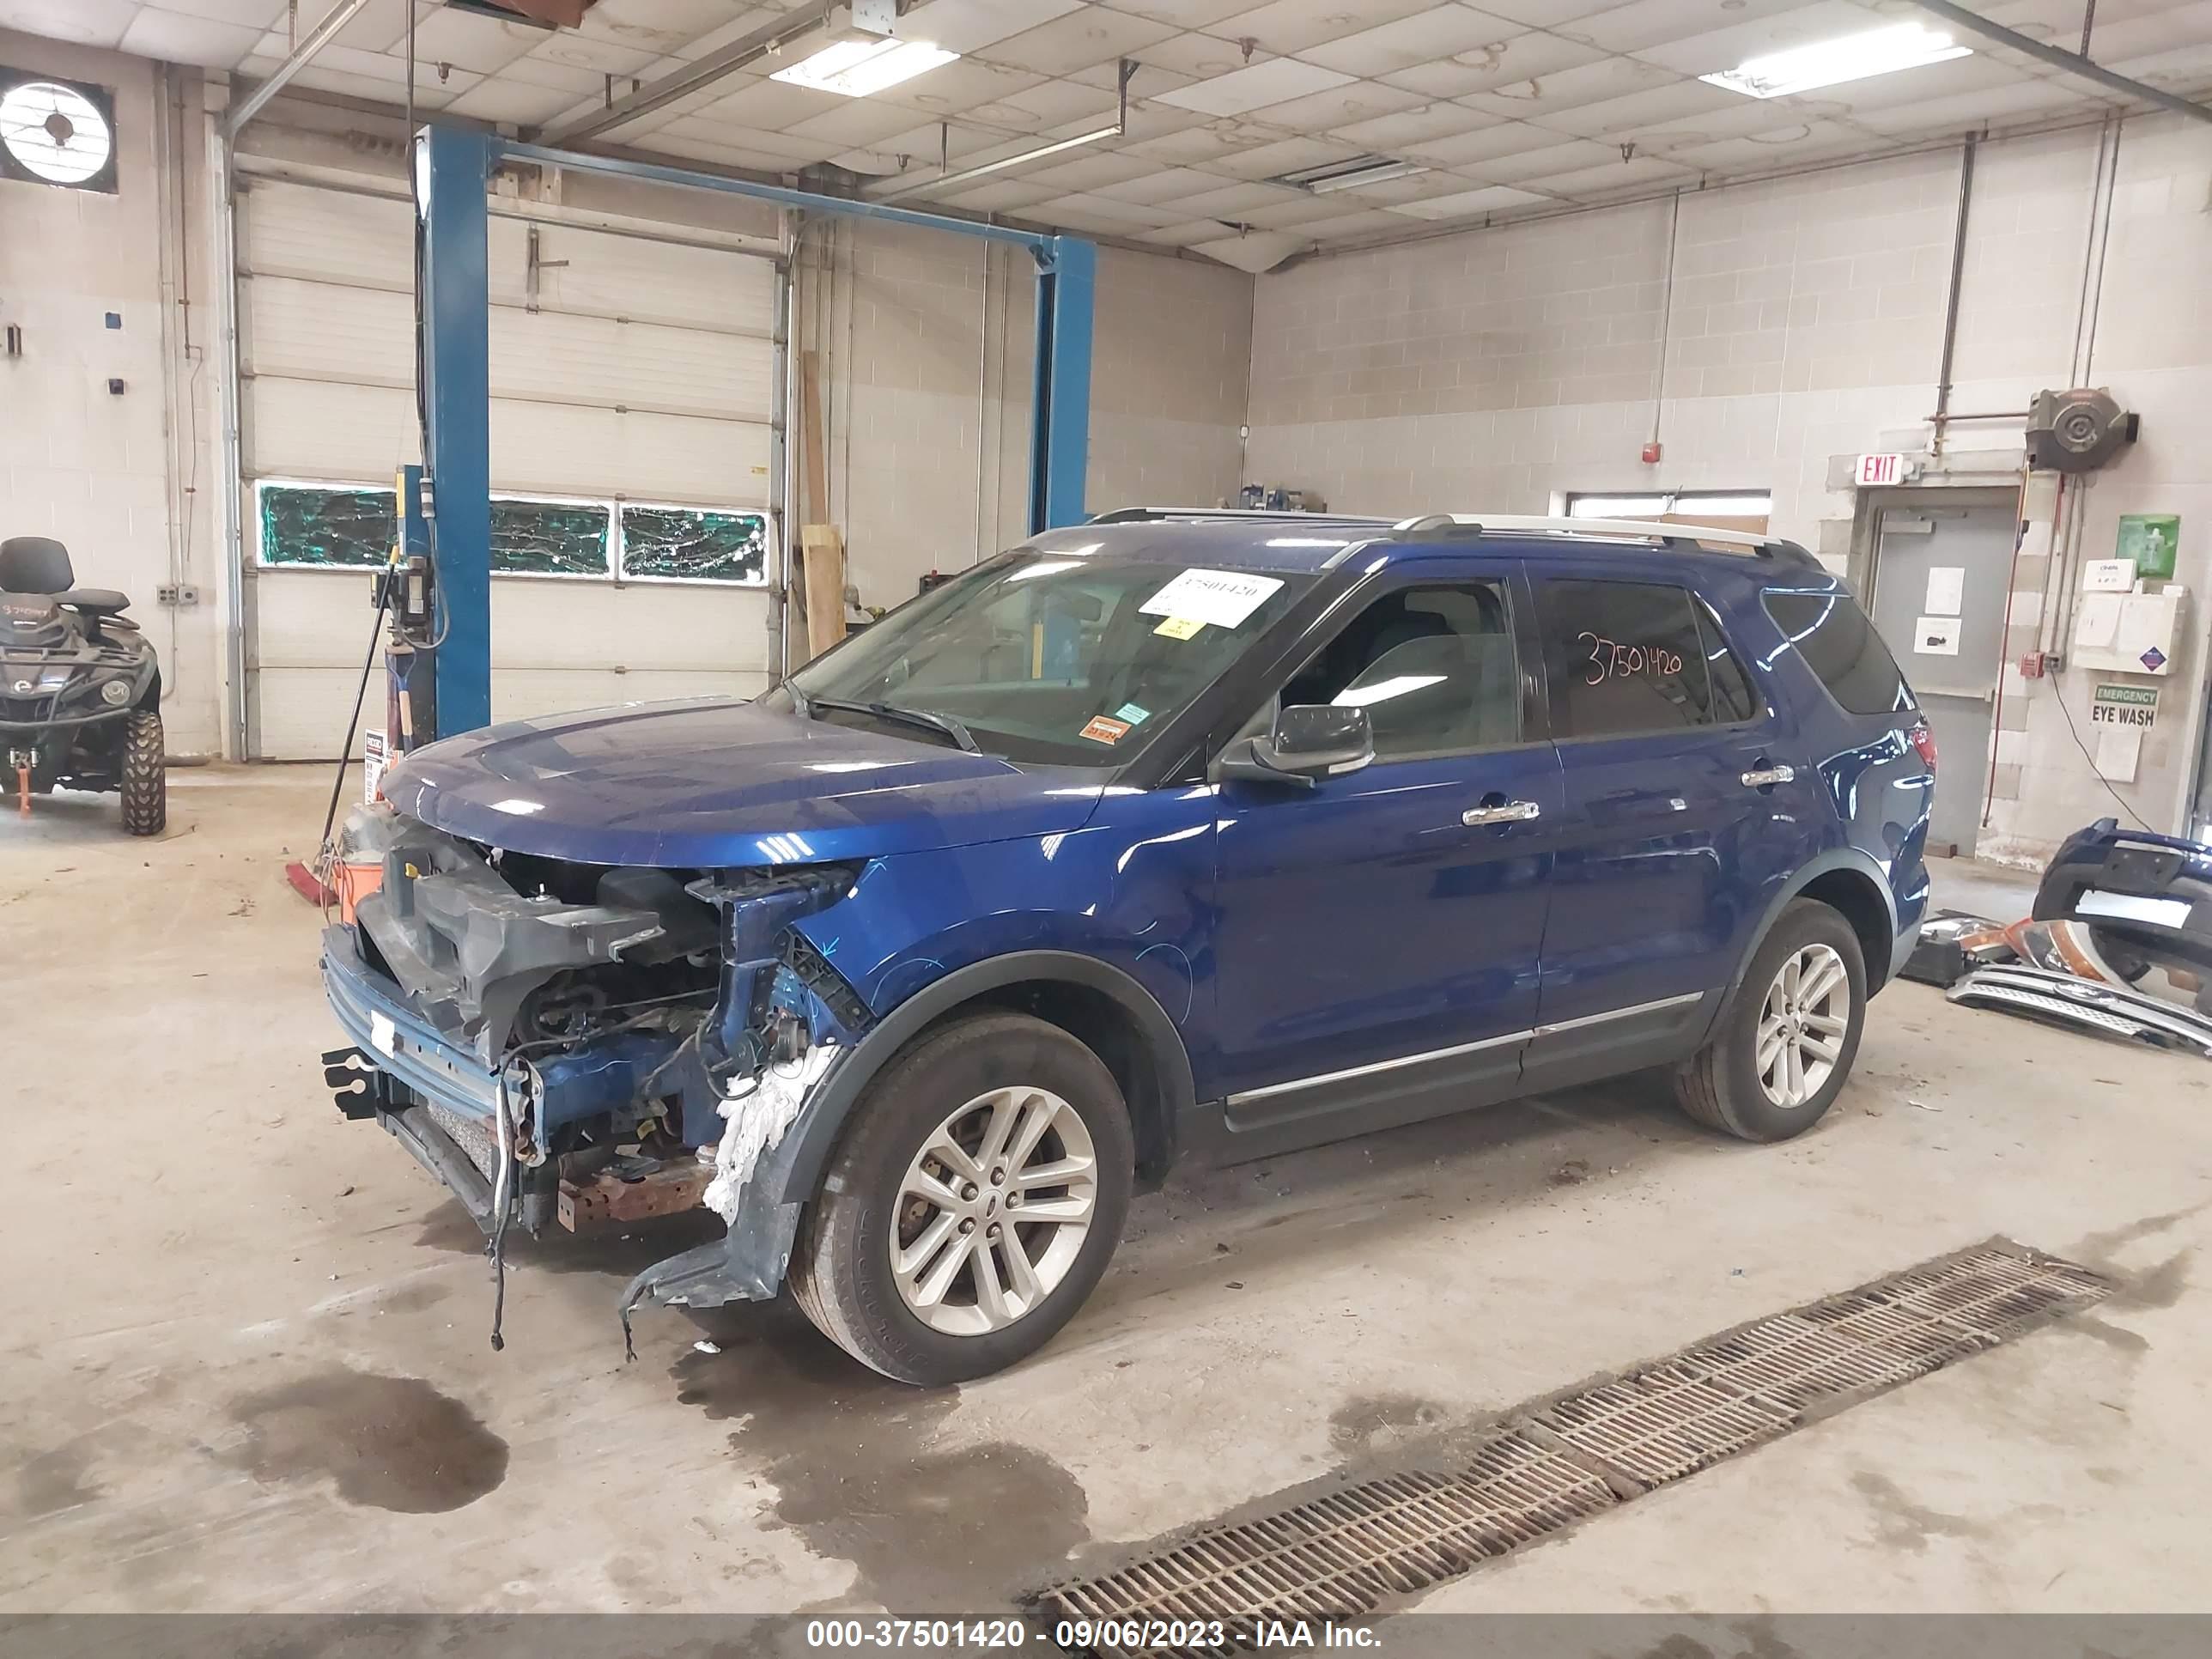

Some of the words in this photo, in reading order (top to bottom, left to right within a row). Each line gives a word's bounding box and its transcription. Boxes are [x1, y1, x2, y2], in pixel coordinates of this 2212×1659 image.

[1863, 456, 1896, 482] EXIT
[1578, 631, 1682, 685] 37501420
[2097, 688, 2156, 702] EMERGENCY
[2093, 705, 2115, 722] EYE
[2118, 708, 2154, 726] WASH
